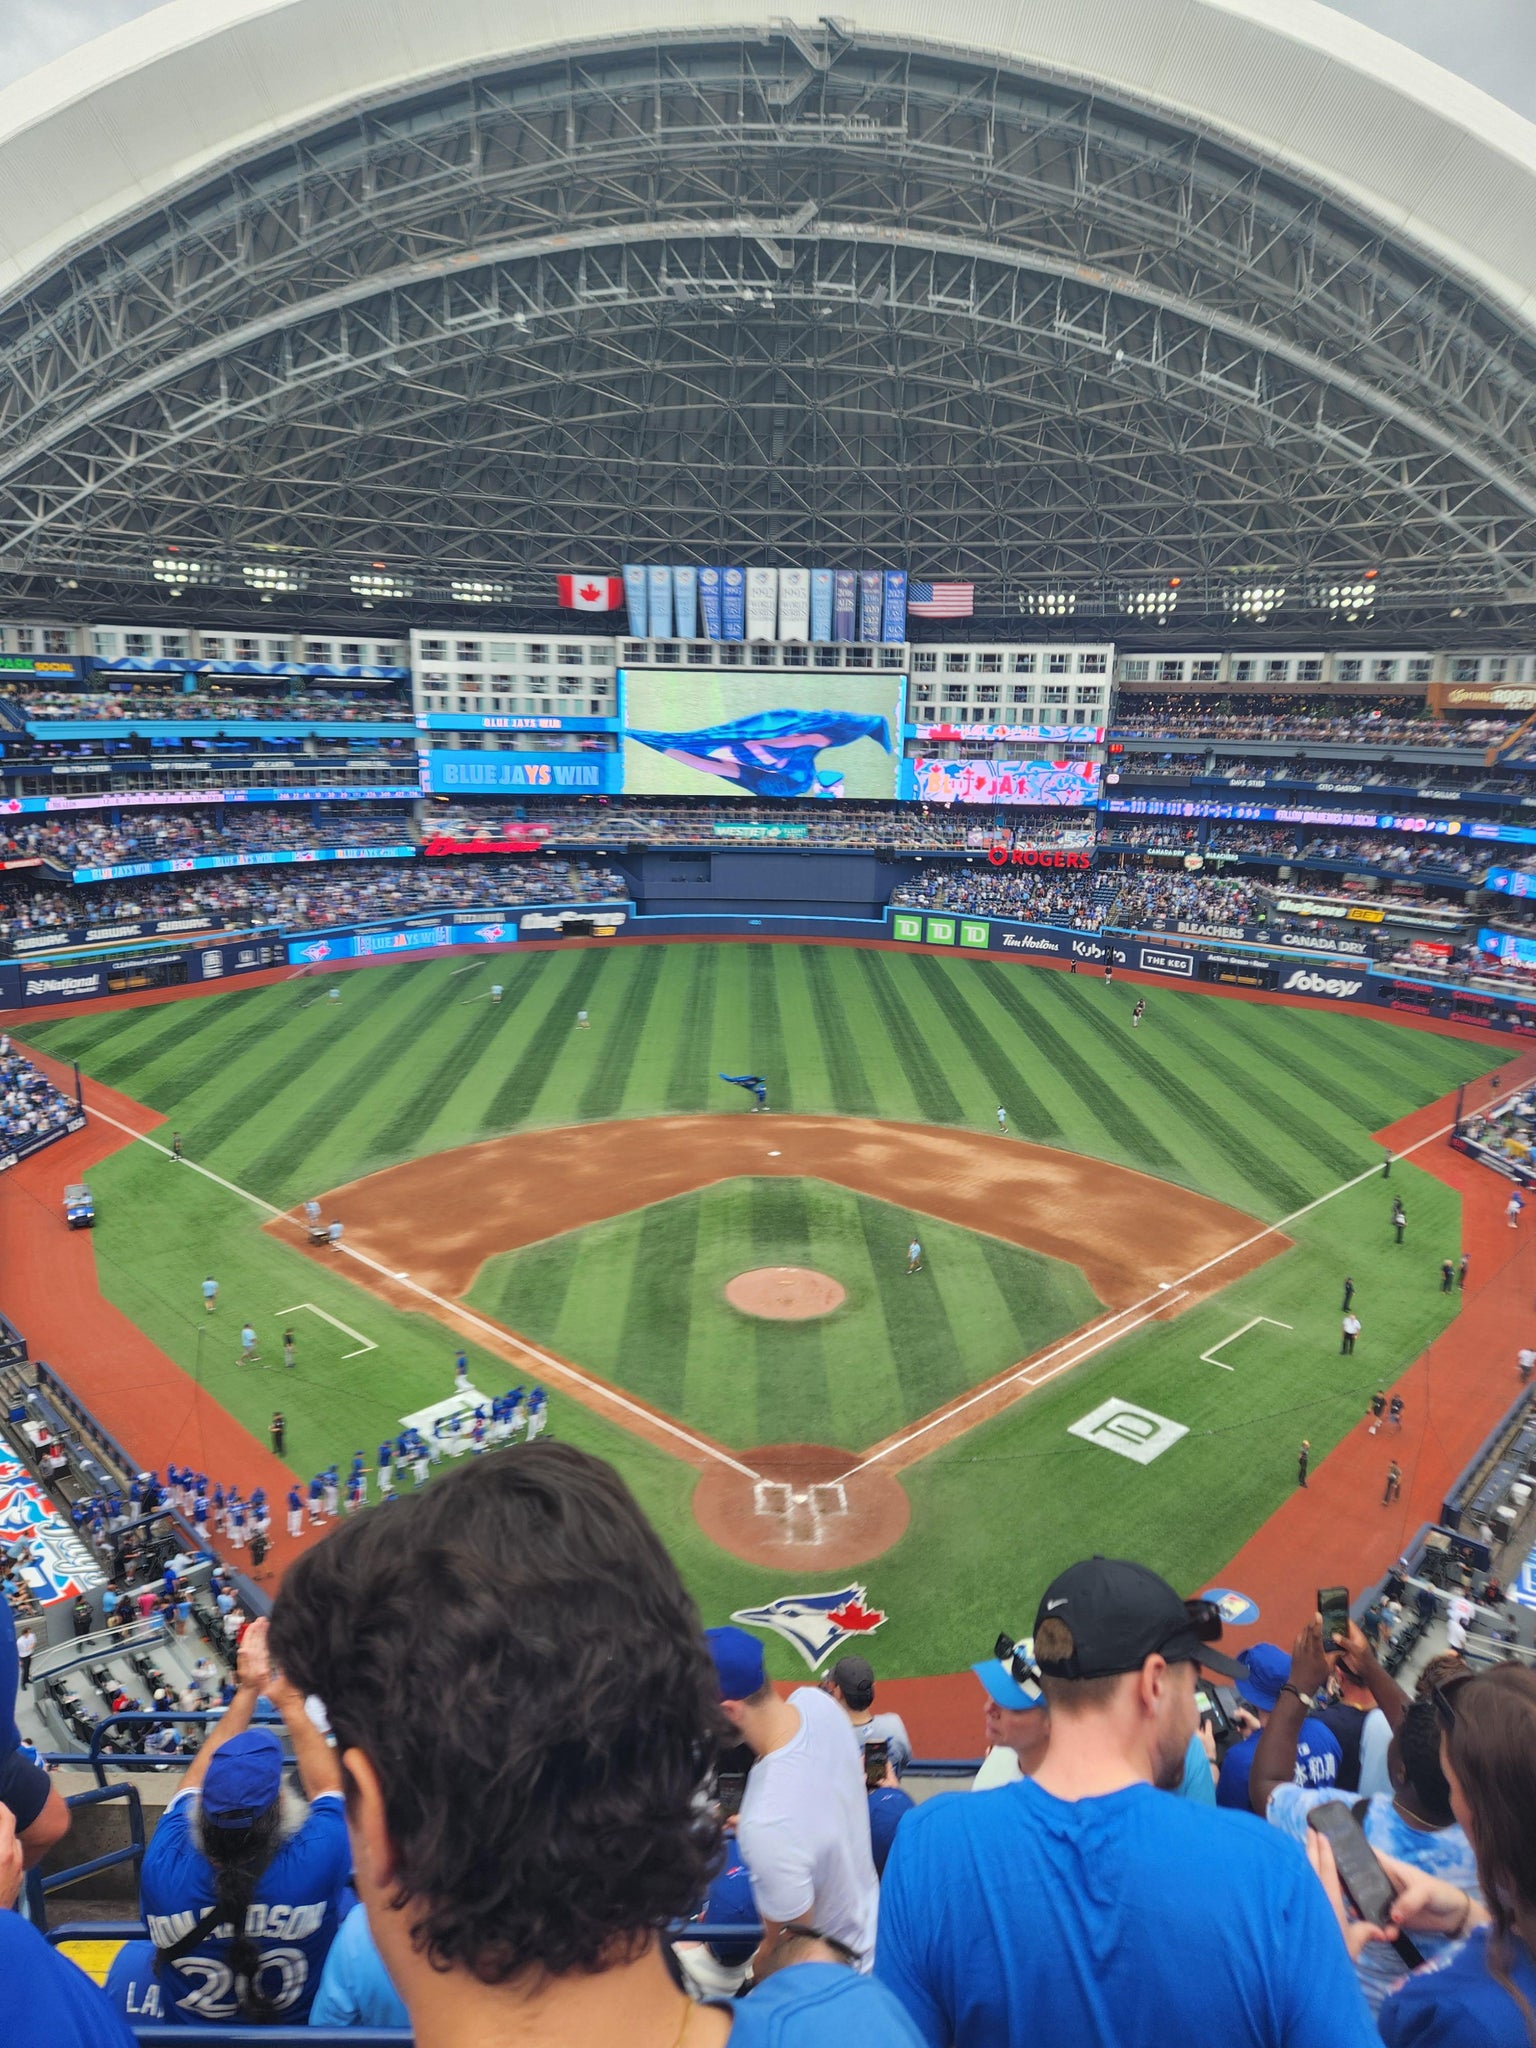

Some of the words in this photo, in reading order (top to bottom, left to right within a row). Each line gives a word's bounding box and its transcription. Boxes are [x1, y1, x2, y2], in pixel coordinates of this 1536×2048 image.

[482, 718, 509, 728] BLUE
[511, 718, 537, 728] JAYS
[443, 764, 497, 786] BLUE
[500, 764, 552, 786] JAYS
[553, 765, 600, 786] WIN
[213, 857, 234, 869] BLUE
[236, 855, 254, 867] JAYS
[256, 853, 274, 866] WIN
[1011, 850, 1091, 869] ROGERS
[1146, 849, 1173, 857] CANADA
[92, 862, 113, 879] BLUE
[114, 862, 134, 876] JAYS
[135, 860, 152, 874] WIN
[1277, 899, 1347, 918] theScore
[1351, 908, 1384, 921] BET
[898, 920, 919, 937] TD
[930, 923, 953, 939] TD
[964, 926, 987, 942] TD
[1177, 922, 1245, 940] BLEACHERS
[393, 933, 418, 948] JAYS
[1002, 934, 1021, 947] Tim
[1021, 935, 1060, 951] Hortons
[1281, 933, 1337, 951] CANADA
[1147, 955, 1166, 966] THE
[1167, 959, 1187, 969] KEG
[42, 973, 100, 992] National
[1283, 969, 1363, 998] Sobeys
[1090, 1411, 1162, 1446] TD
[171, 1947, 309, 2019] 20
